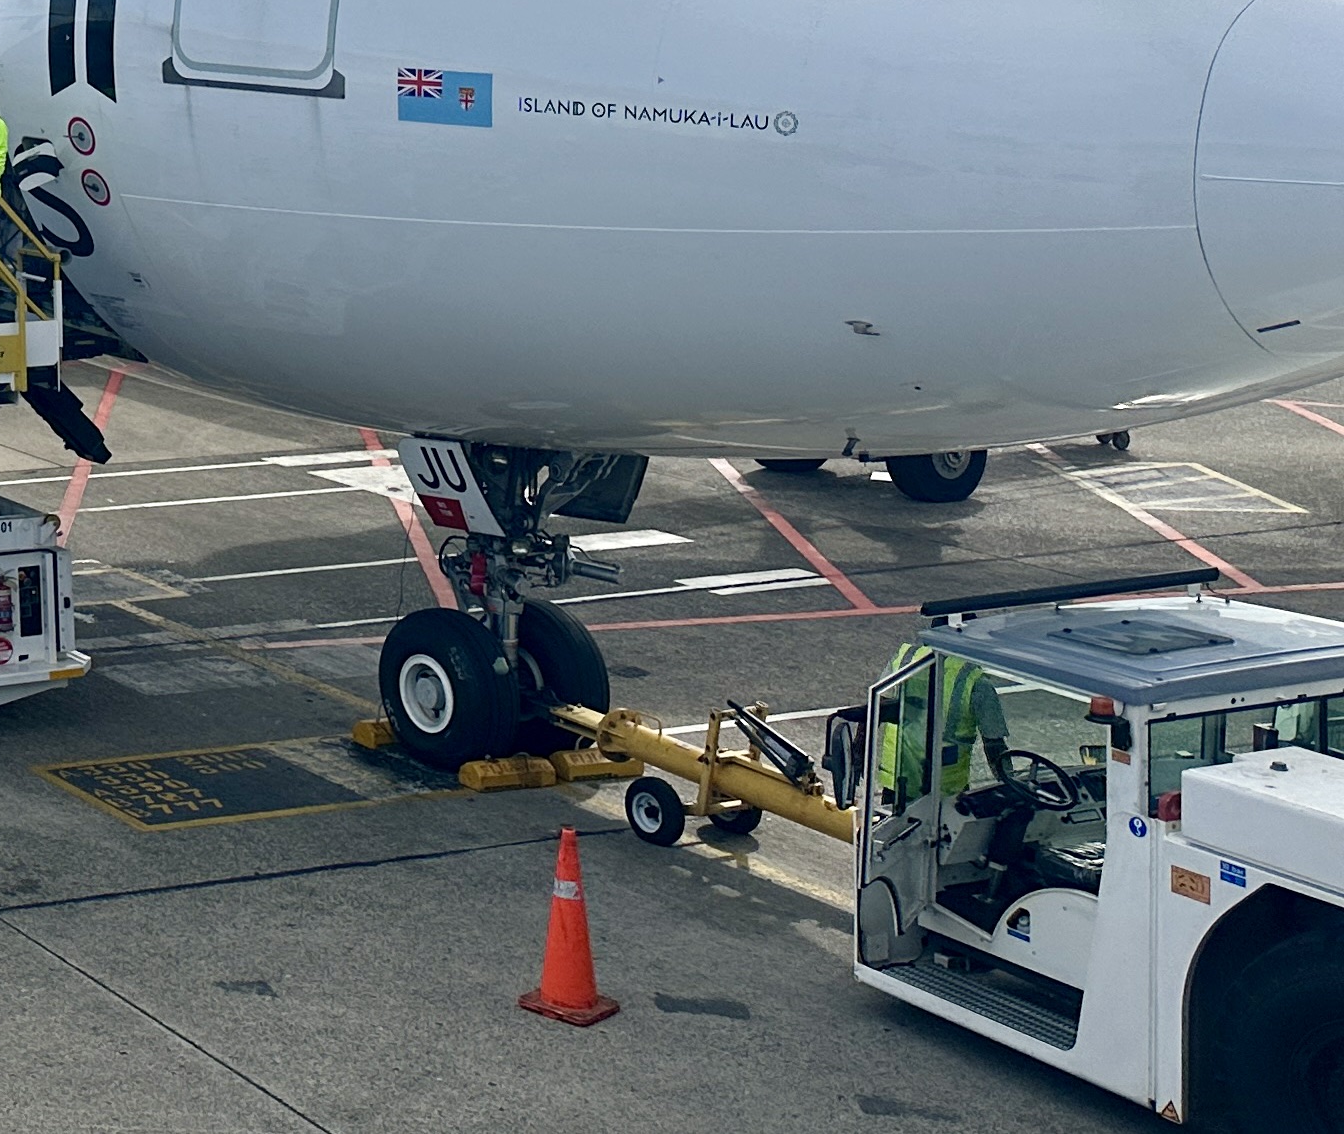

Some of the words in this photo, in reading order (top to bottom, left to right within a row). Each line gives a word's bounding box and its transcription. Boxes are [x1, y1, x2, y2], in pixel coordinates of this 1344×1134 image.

[518, 97, 585, 116] ISLAND
[591, 102, 617, 118] OF
[417, 446, 467, 493] JU
